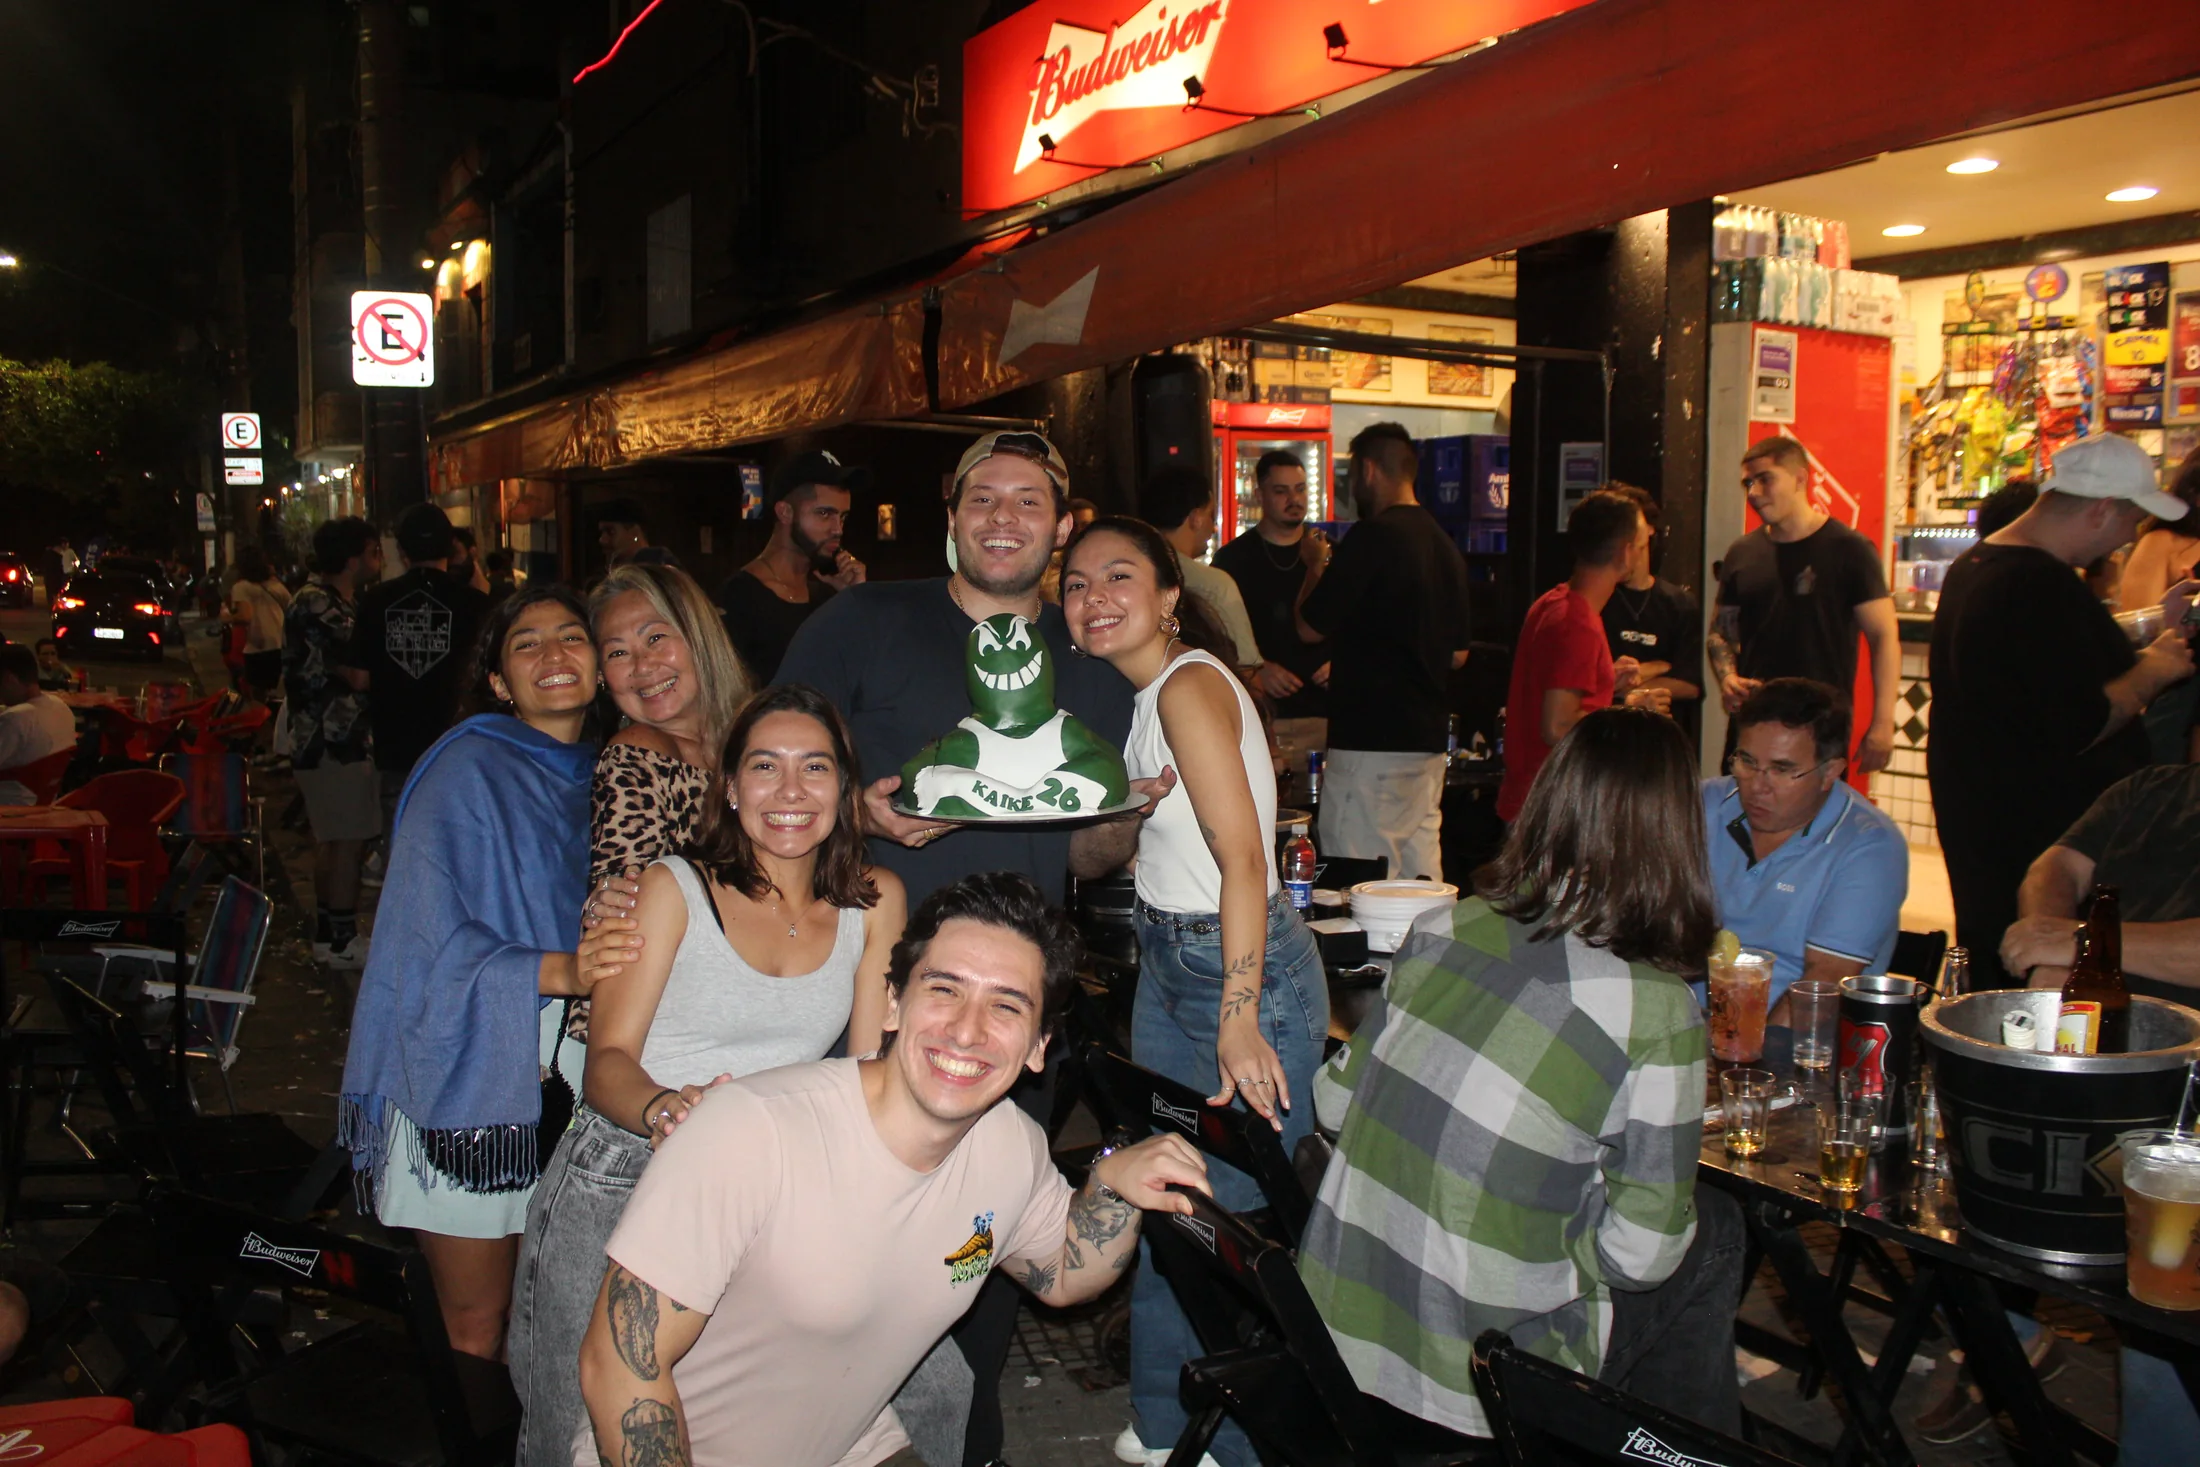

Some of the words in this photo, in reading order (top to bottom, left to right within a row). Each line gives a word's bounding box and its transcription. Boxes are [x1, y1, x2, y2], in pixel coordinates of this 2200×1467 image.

[1027, 0, 1223, 125] Budweiser
[381, 314, 403, 350] E
[236, 423, 248, 440] E
[972, 780, 1034, 812] KAIKE
[1035, 777, 1081, 812] 26
[1151, 1096, 1196, 1125] Budweiser
[243, 1236, 312, 1266] Budweiser
